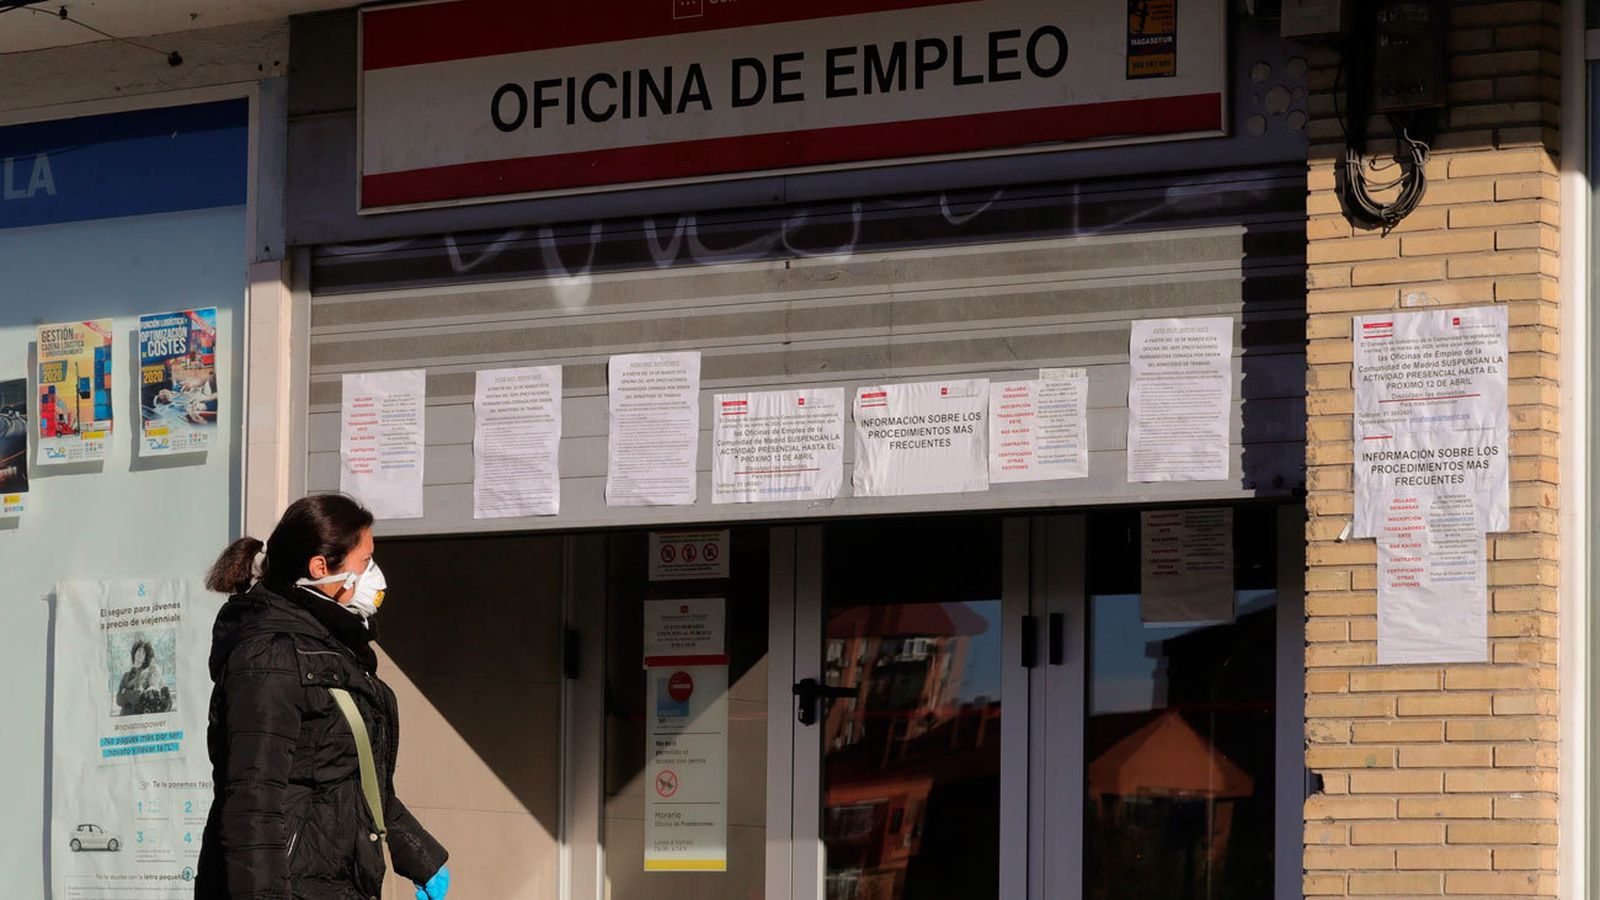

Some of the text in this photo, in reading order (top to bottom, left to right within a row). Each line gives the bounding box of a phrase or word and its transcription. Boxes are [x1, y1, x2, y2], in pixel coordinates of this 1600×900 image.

[490, 25, 1068, 132] OFICINA DE EMPLEO
[4, 152, 56, 200] LA
[41, 326, 74, 343] GESTIÓN
[148, 338, 186, 357] COSTES
[1378, 353, 1388, 362] las
[1390, 351, 1421, 361] Oficinas
[1423, 351, 1432, 359] de
[1435, 349, 1462, 358] Empleo
[1358, 363, 1401, 373] Comunidad
[1413, 360, 1439, 369] Madrid
[1441, 357, 1489, 367] SUSPENDAN
[1492, 356, 1503, 364] LA
[43, 371, 62, 383] 2020
[144, 371, 163, 384] 2020
[1363, 366, 1498, 382] ACTIVIDAD PRESENCIAL HASTA EL
[1426, 380, 1434, 388] 12
[1436, 379, 1448, 387] DE
[1450, 377, 1472, 386] ABRIL
[928, 413, 961, 424] SOBRE
[962, 411, 982, 421] LOS
[745, 428, 771, 437] Oficinas
[782, 427, 806, 435] Empleo
[868, 425, 951, 440] PROCEDIMIENTOS
[717, 438, 753, 447] Comunidad
[763, 437, 786, 445] Madrid
[787, 434, 829, 443] SUSPENDAN
[831, 433, 840, 441] LA
[889, 437, 952, 450] FRECUENTES
[720, 447, 757, 455] ACTIVIDAD
[758, 445, 800, 453] PRESENCIAL
[802, 443, 825, 451] HASTA
[1437, 447, 1474, 459] SOBRE
[1477, 445, 1499, 456] LOS
[794, 453, 814, 461] ABRIL
[1370, 460, 1463, 475] PROCEDIMIENTOS
[1395, 474, 1465, 487] FRECUENTES
[101, 600, 181, 618] El seguro para jóvenes
[106, 619, 129, 631] precio
[130, 617, 139, 627] de
[141, 614, 181, 627] viejennials
[114, 720, 166, 732] #novatospower
[104, 731, 180, 746] No pagues más por ser
[108, 748, 130, 756] novato
[168, 781, 197, 789] ponemos
[137, 801, 192, 813] 1 2
[654, 810, 681, 819] Horario
[136, 831, 192, 843] 3 4
